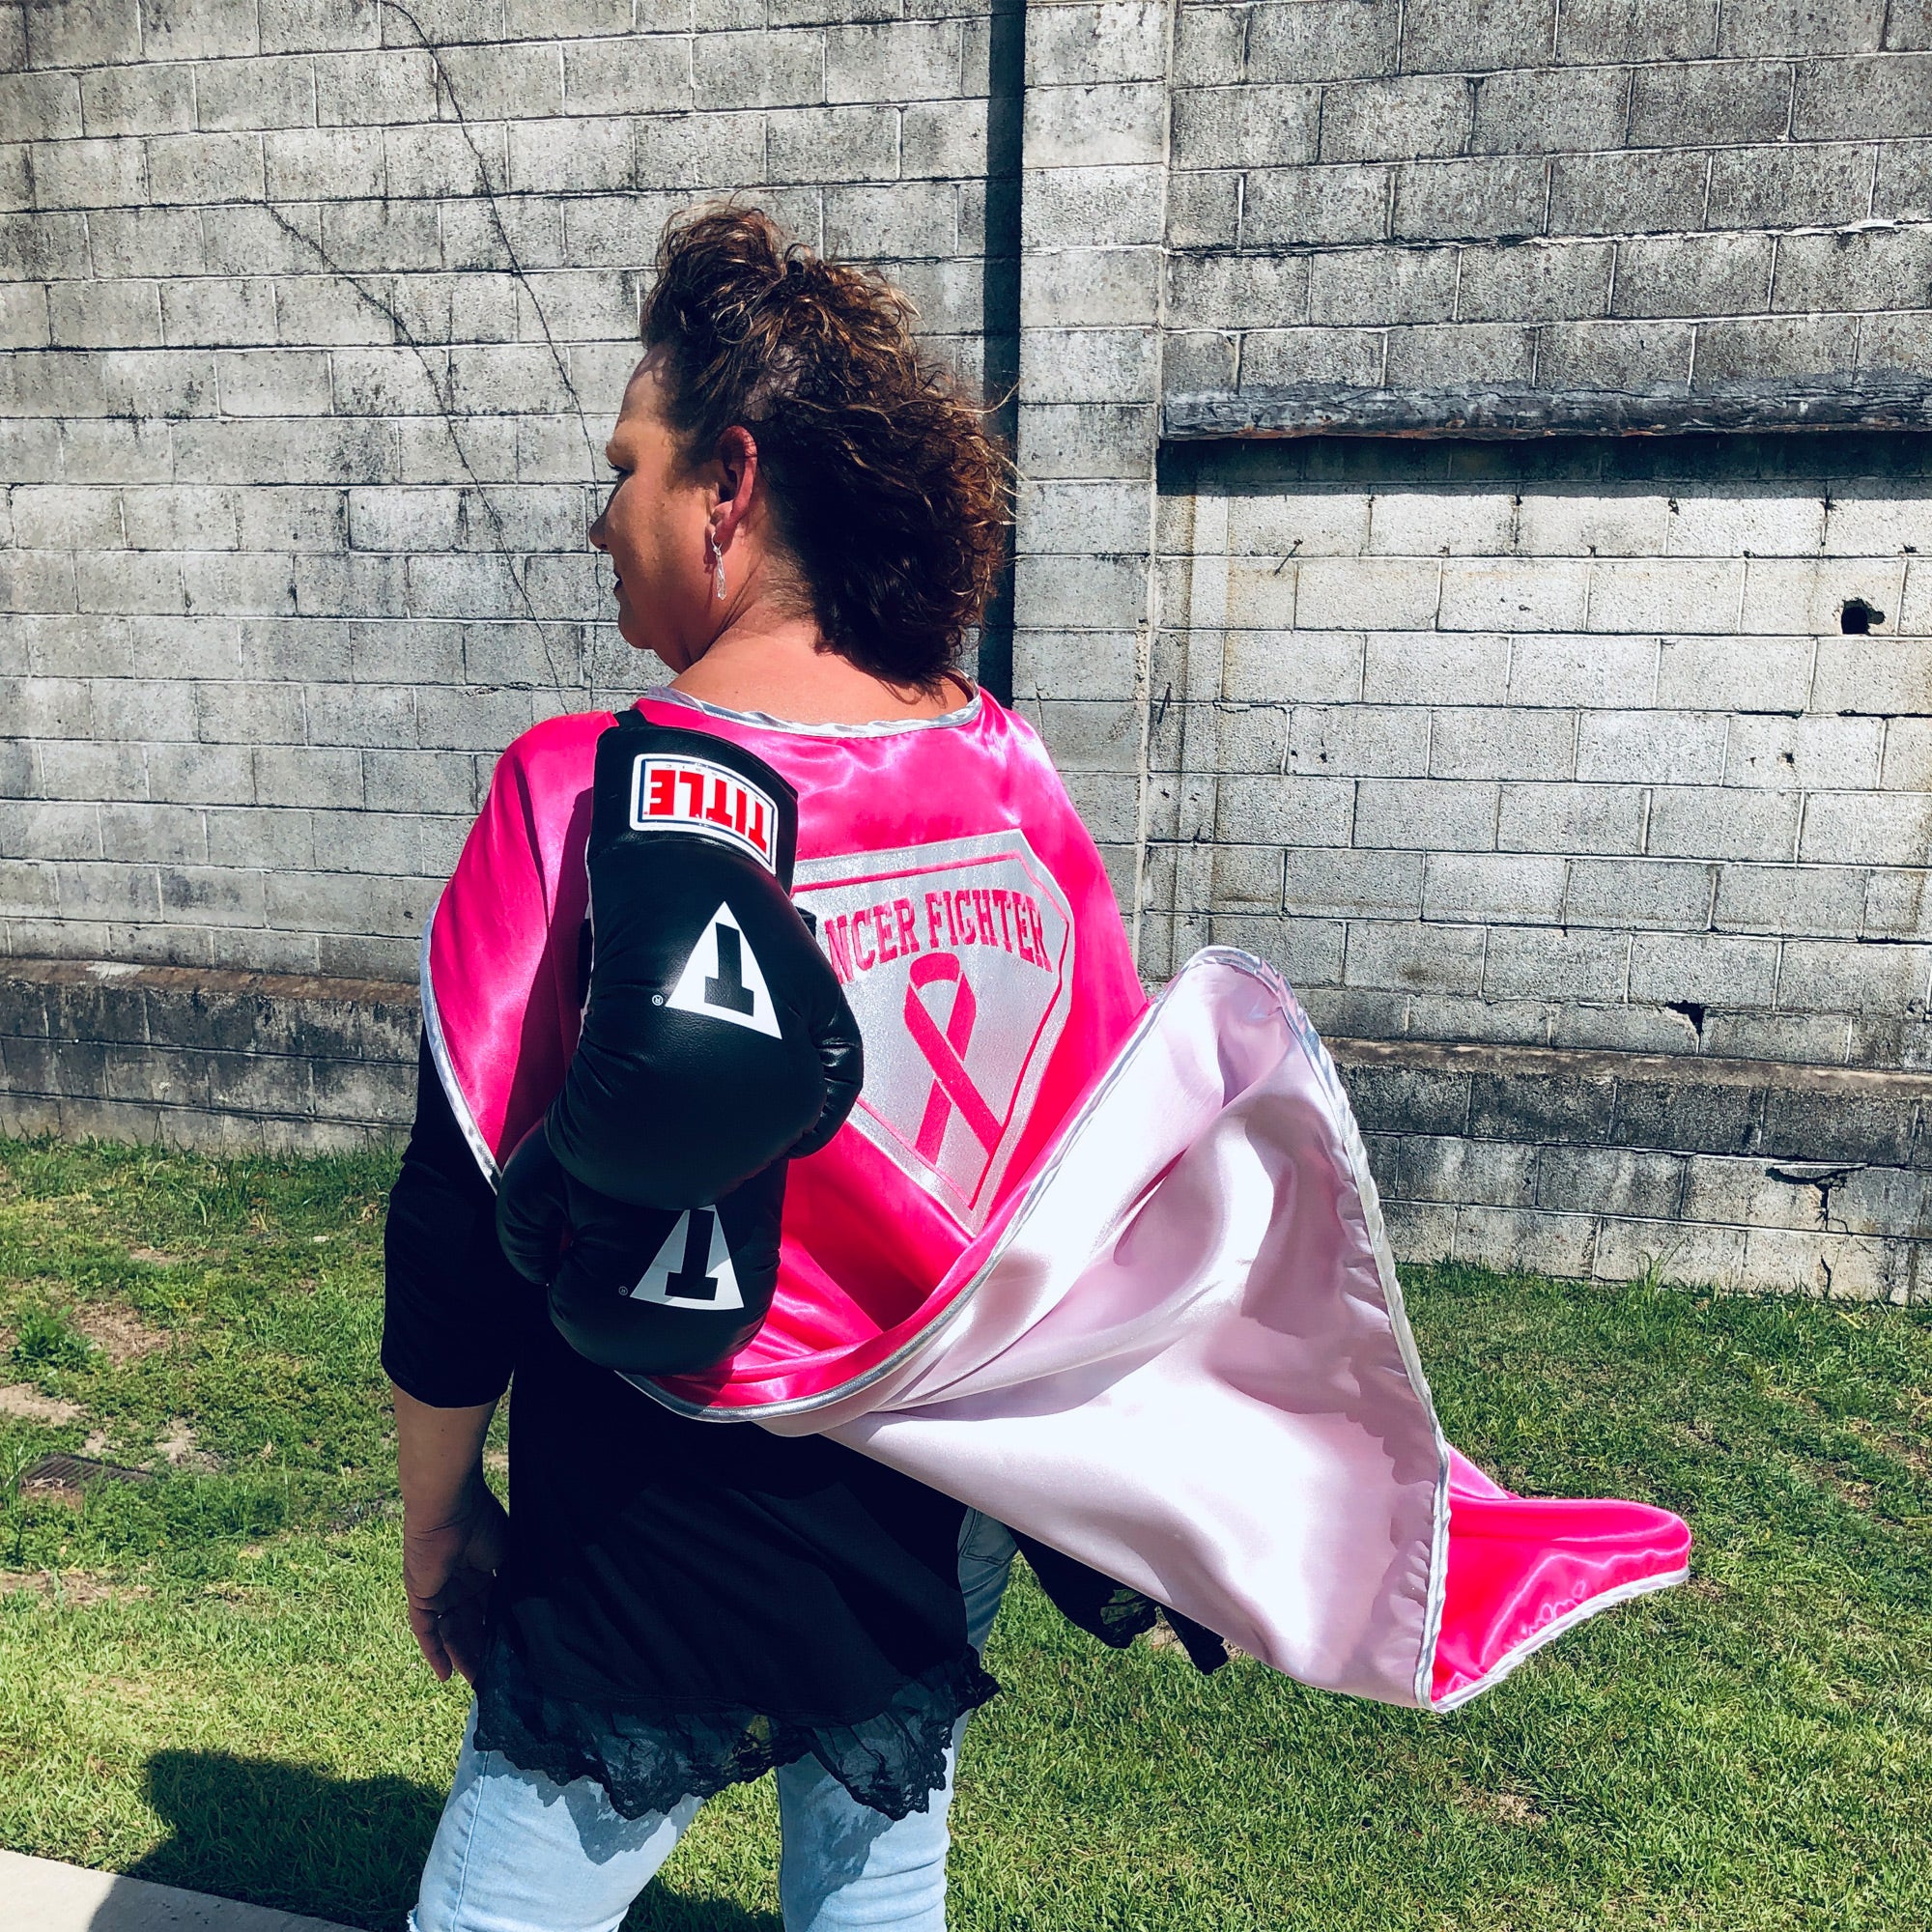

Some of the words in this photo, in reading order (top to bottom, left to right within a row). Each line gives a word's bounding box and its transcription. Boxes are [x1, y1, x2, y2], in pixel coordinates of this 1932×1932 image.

[649, 770, 767, 855] TITLE
[825, 896, 920, 984] NCER
[925, 889, 1053, 973] FIGHTER
